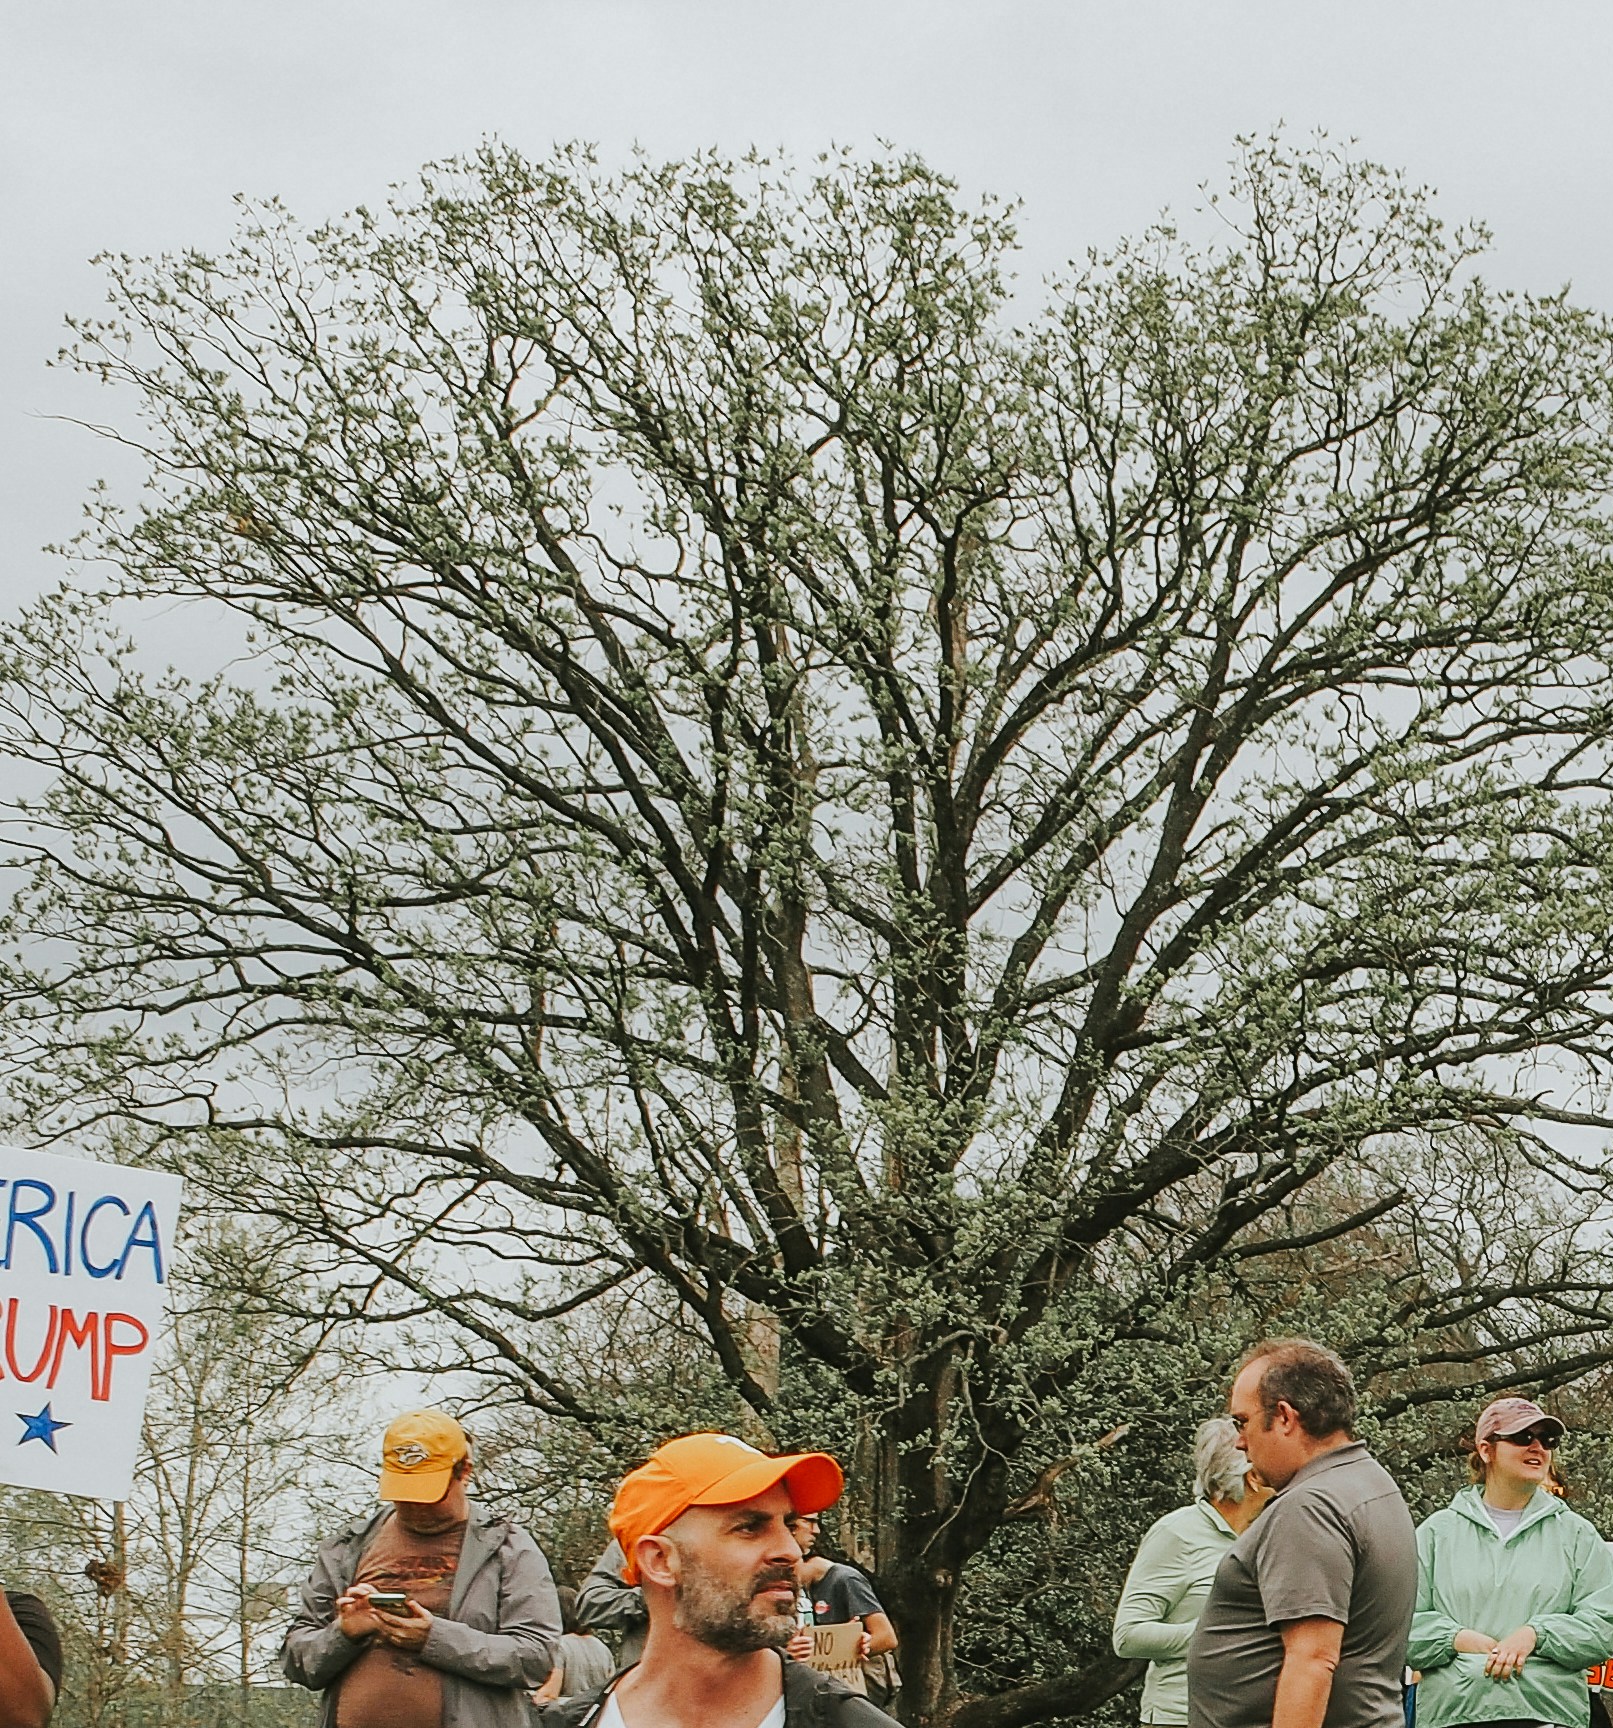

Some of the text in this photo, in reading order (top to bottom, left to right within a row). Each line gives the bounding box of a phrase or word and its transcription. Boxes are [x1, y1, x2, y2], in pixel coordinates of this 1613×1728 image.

[0, 1179, 164, 1284] RICA
[0, 1297, 149, 1401] UMP
[813, 1631, 834, 1656] NO
